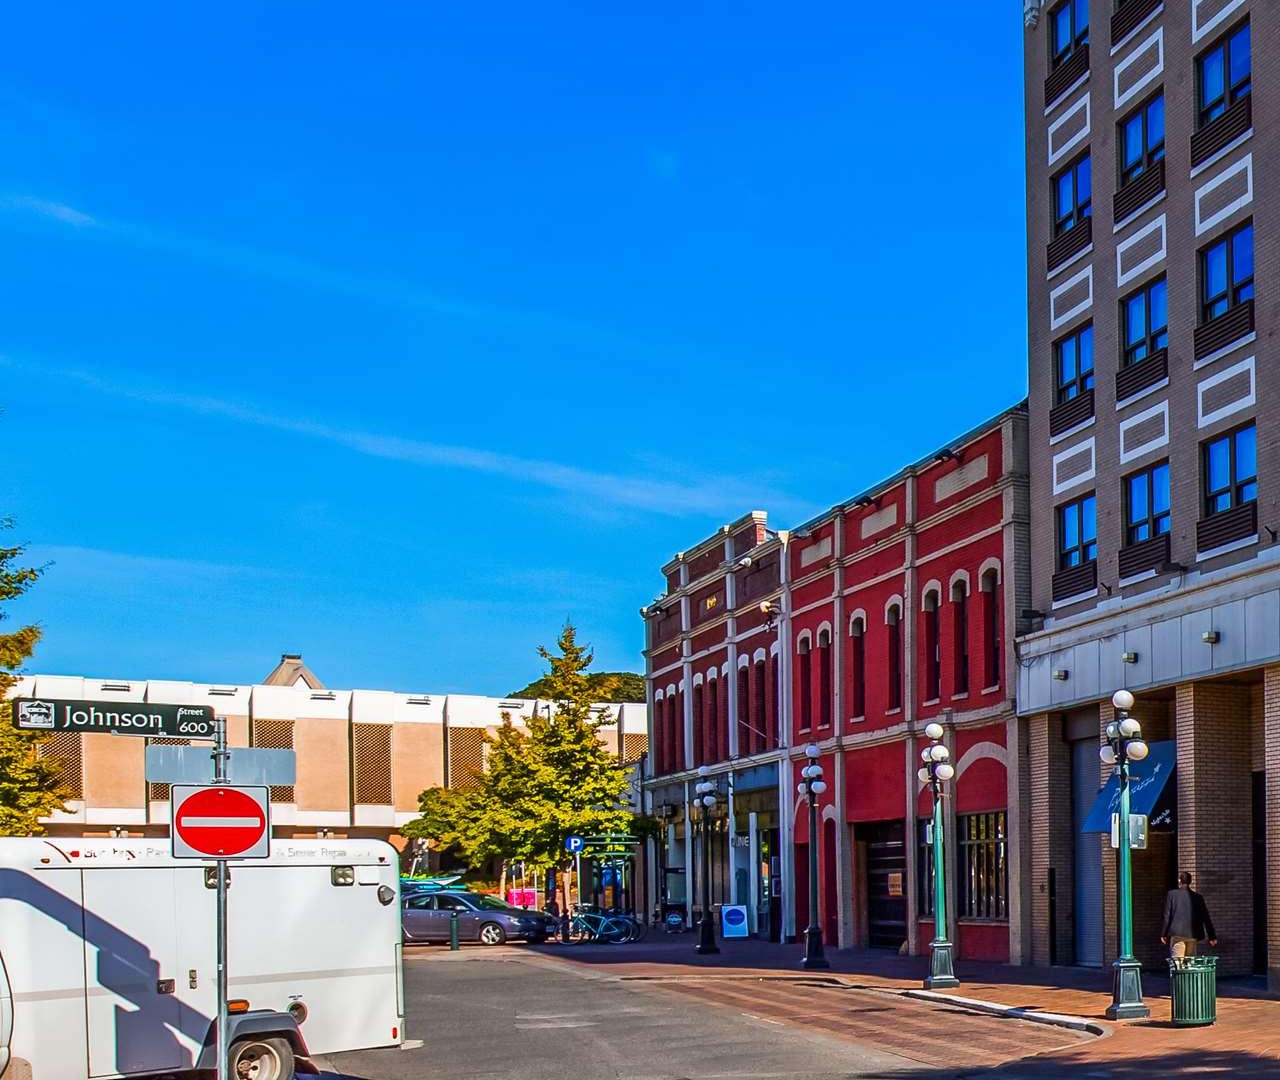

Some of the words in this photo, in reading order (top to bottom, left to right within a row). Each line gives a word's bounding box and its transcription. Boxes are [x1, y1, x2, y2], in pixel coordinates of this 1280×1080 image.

[63, 705, 163, 728] Johnson
[178, 707, 204, 717] Street
[179, 722, 208, 733] 600
[570, 838, 581, 850] P
